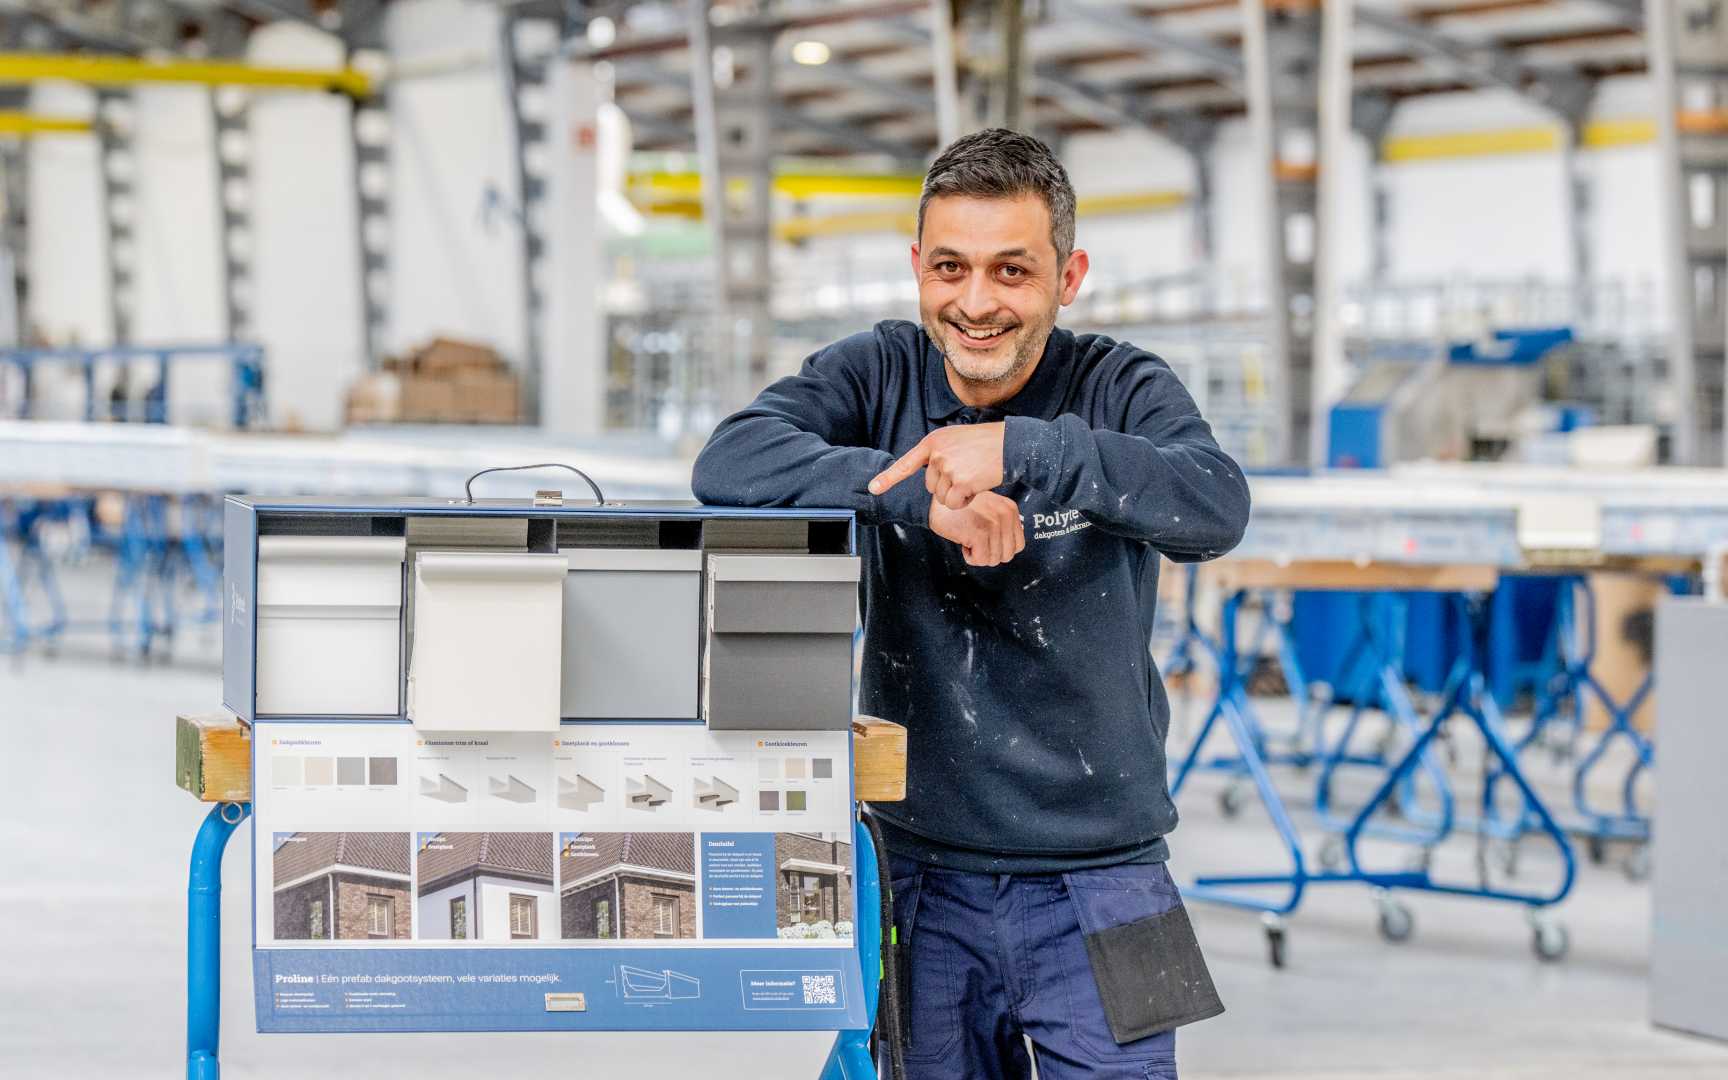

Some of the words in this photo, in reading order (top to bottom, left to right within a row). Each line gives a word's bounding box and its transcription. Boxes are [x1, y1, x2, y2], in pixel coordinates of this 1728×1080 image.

[275, 974, 313, 984] Proline
[341, 974, 372, 985] prefab
[374, 974, 455, 986] dakgootsysteem,
[456, 973, 476, 983] vele
[478, 974, 518, 983] variaties
